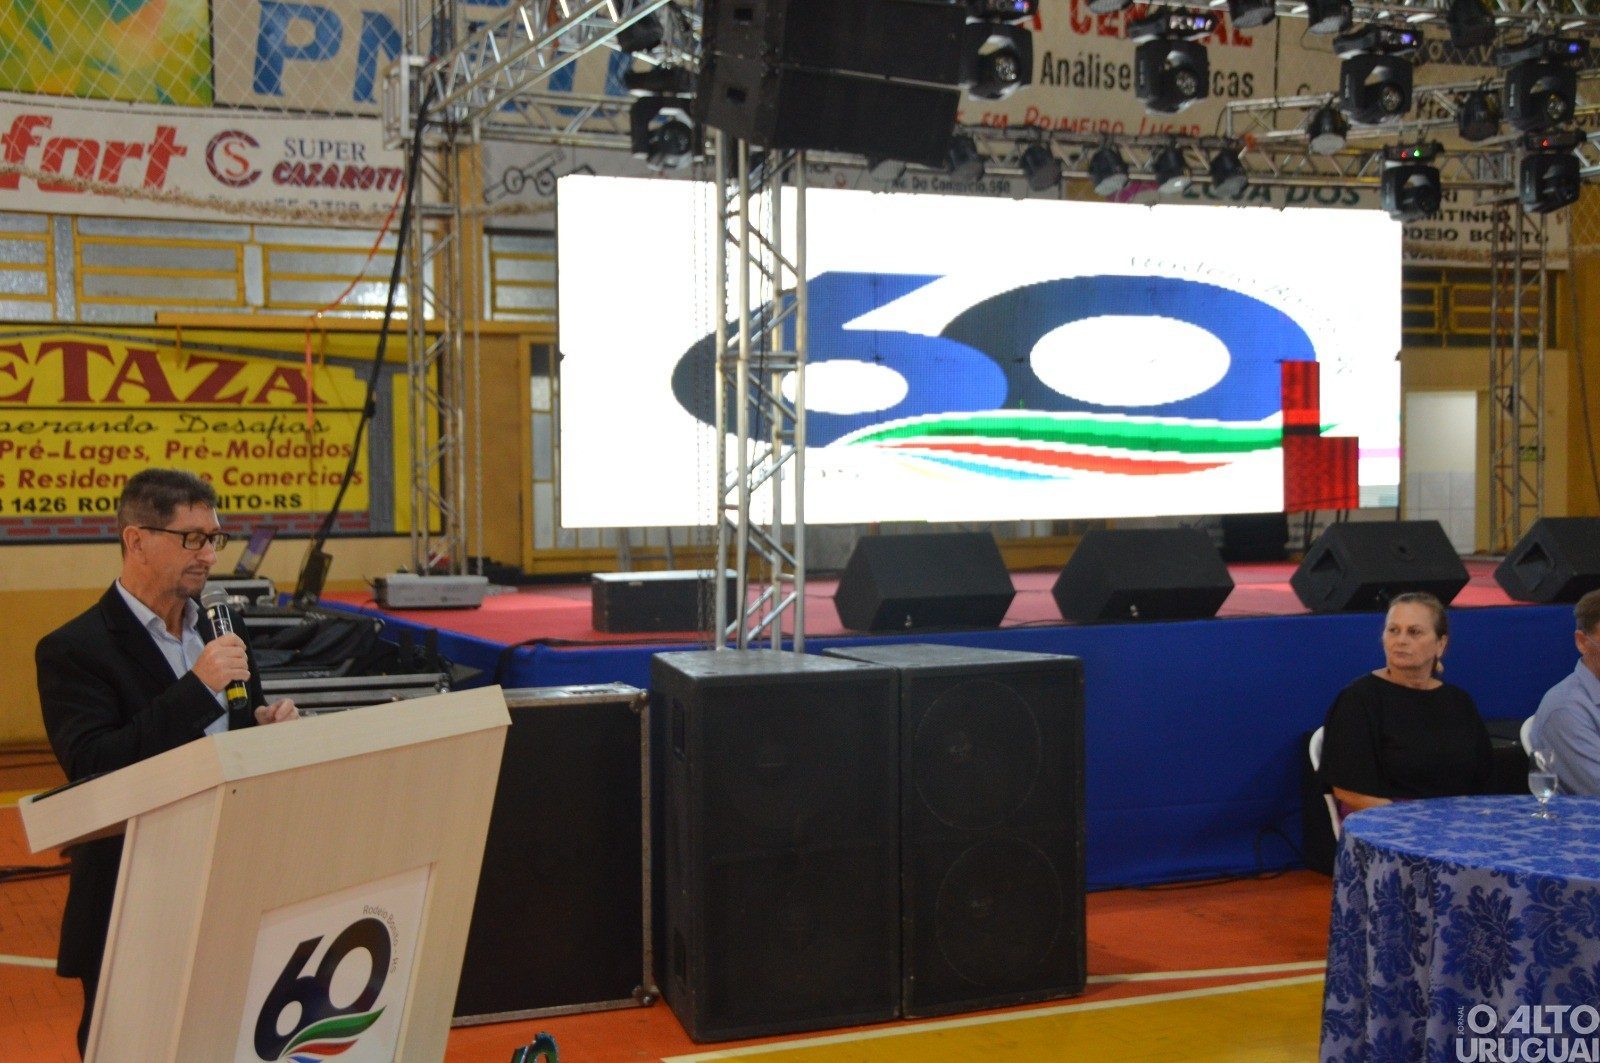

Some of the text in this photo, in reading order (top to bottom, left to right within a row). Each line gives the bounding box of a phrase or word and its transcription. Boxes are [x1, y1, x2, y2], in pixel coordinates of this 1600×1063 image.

[284, 137, 367, 162] SUPER
[672, 271, 1318, 448] 60
[223, 466, 363, 488] Comercias
[13, 498, 67, 512] 1426
[254, 917, 391, 1061] 60
